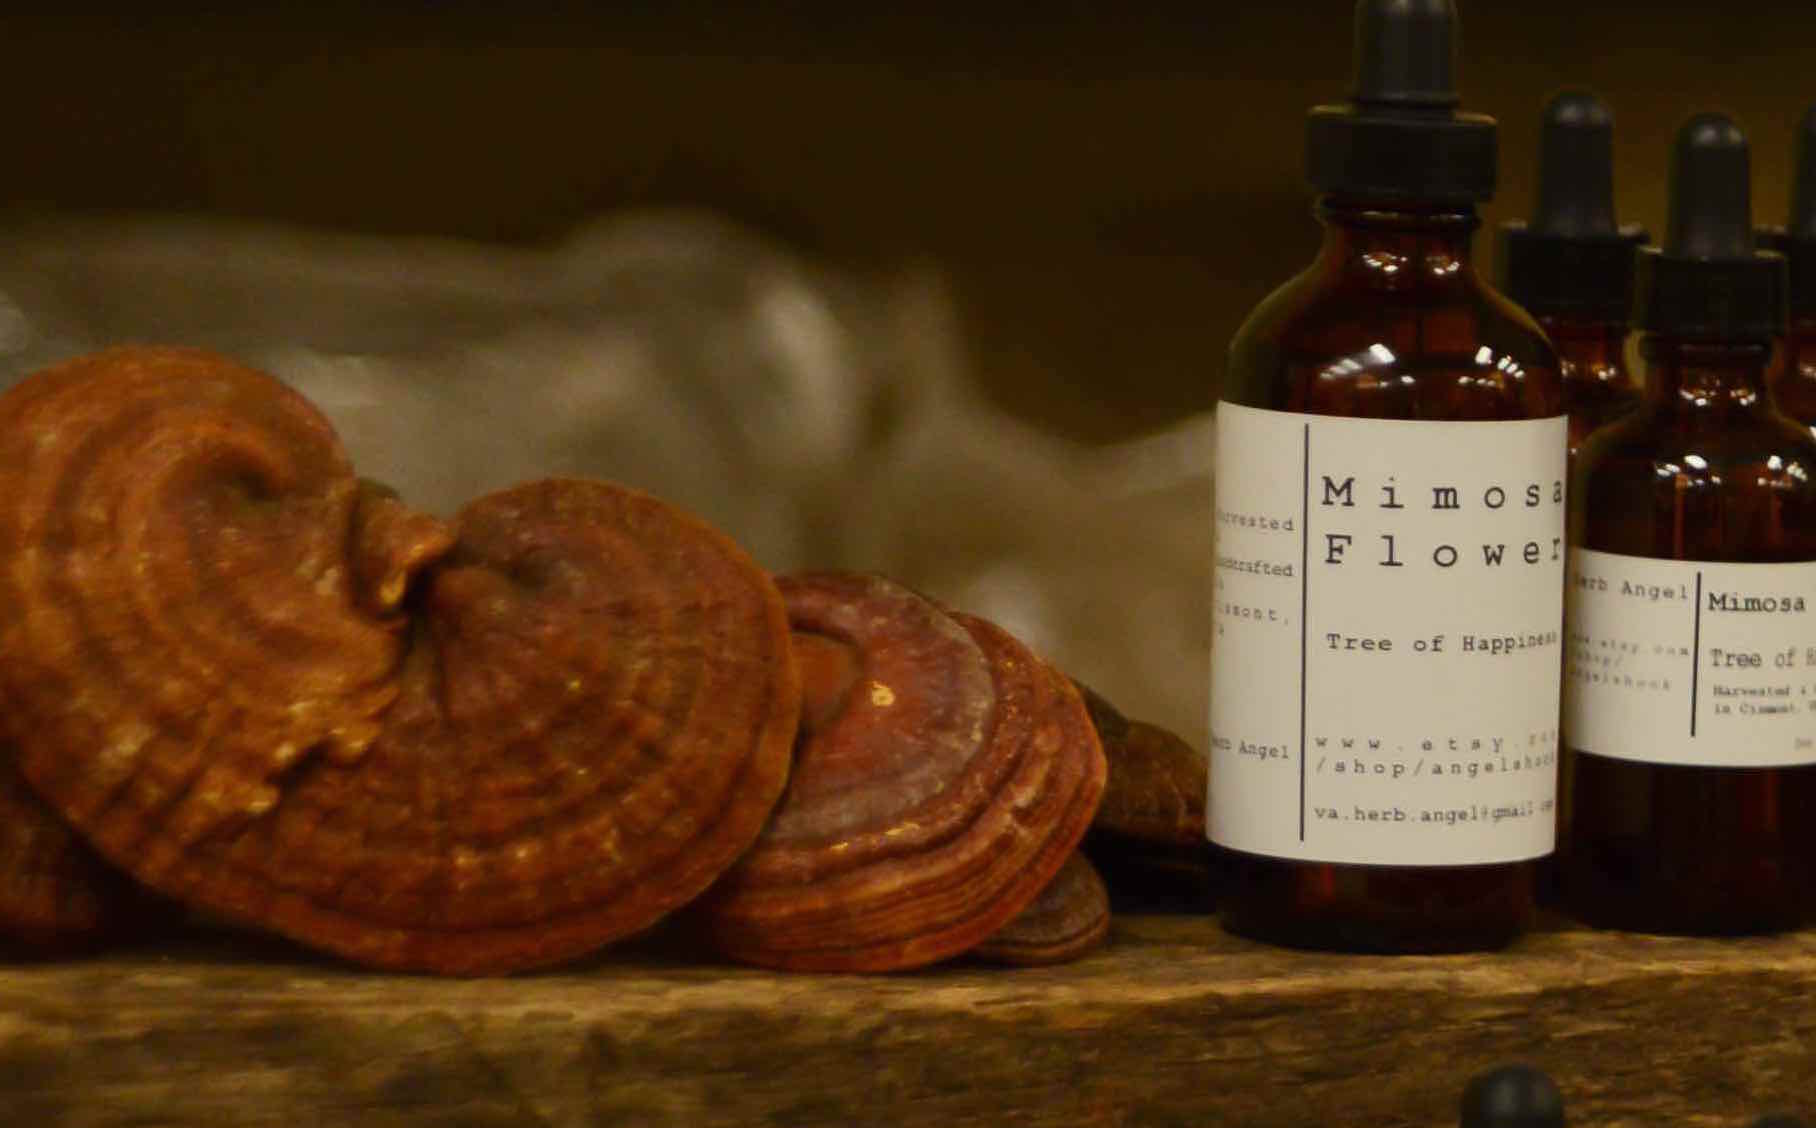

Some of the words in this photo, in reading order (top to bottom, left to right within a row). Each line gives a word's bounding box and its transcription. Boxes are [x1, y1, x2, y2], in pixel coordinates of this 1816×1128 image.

[1321, 474, 1563, 510] Mimosa
[1324, 533, 1562, 568] Flower
[1621, 581, 1689, 602] Angel
[1708, 591, 1806, 613] Mimosa
[1326, 633, 1393, 653] Tree
[1413, 633, 1444, 653] of
[1710, 647, 1763, 670] Tree
[1775, 647, 1797, 668] of
[1239, 739, 1289, 761] Angel
